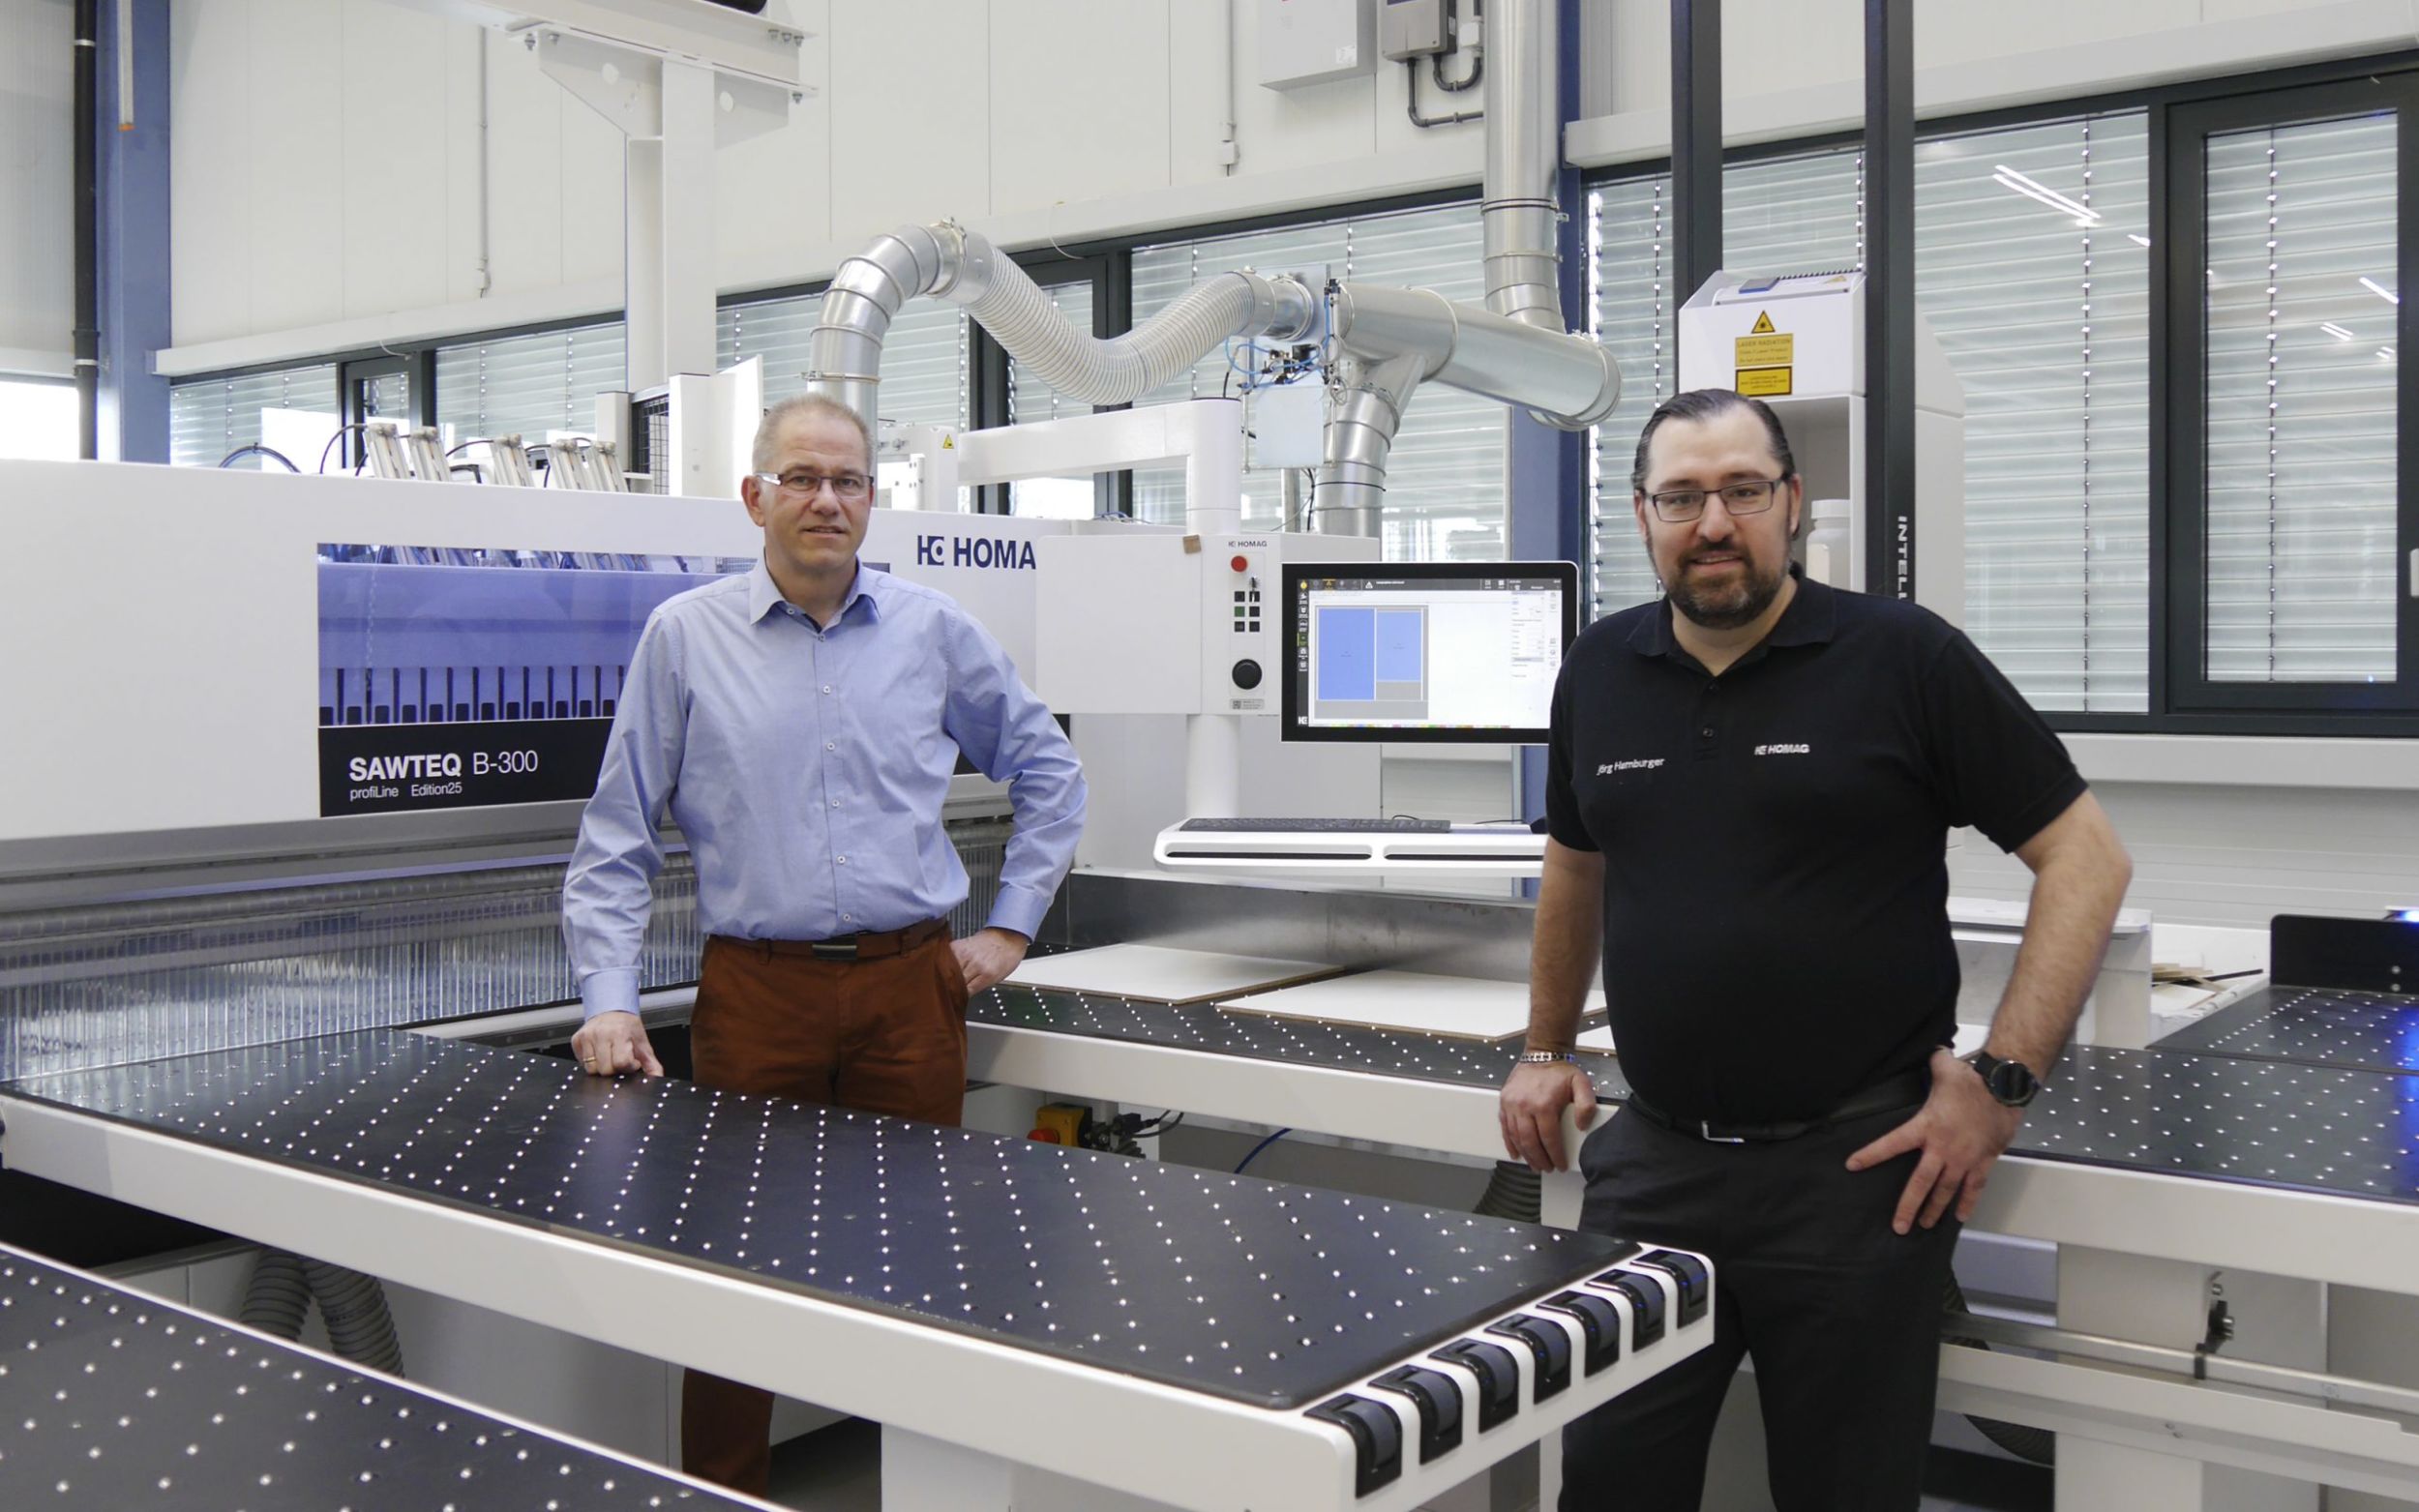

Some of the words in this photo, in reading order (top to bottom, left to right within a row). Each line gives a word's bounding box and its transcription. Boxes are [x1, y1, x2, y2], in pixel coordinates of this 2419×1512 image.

[953, 537, 1036, 570] HOMA
[1768, 743, 1810, 755] HOMAG
[349, 753, 463, 782] SAWTEQ
[473, 750, 539, 775] B-300
[1614, 758, 1665, 771] Hamburger
[349, 786, 399, 802] profiLine
[411, 782, 463, 797] Edition25
